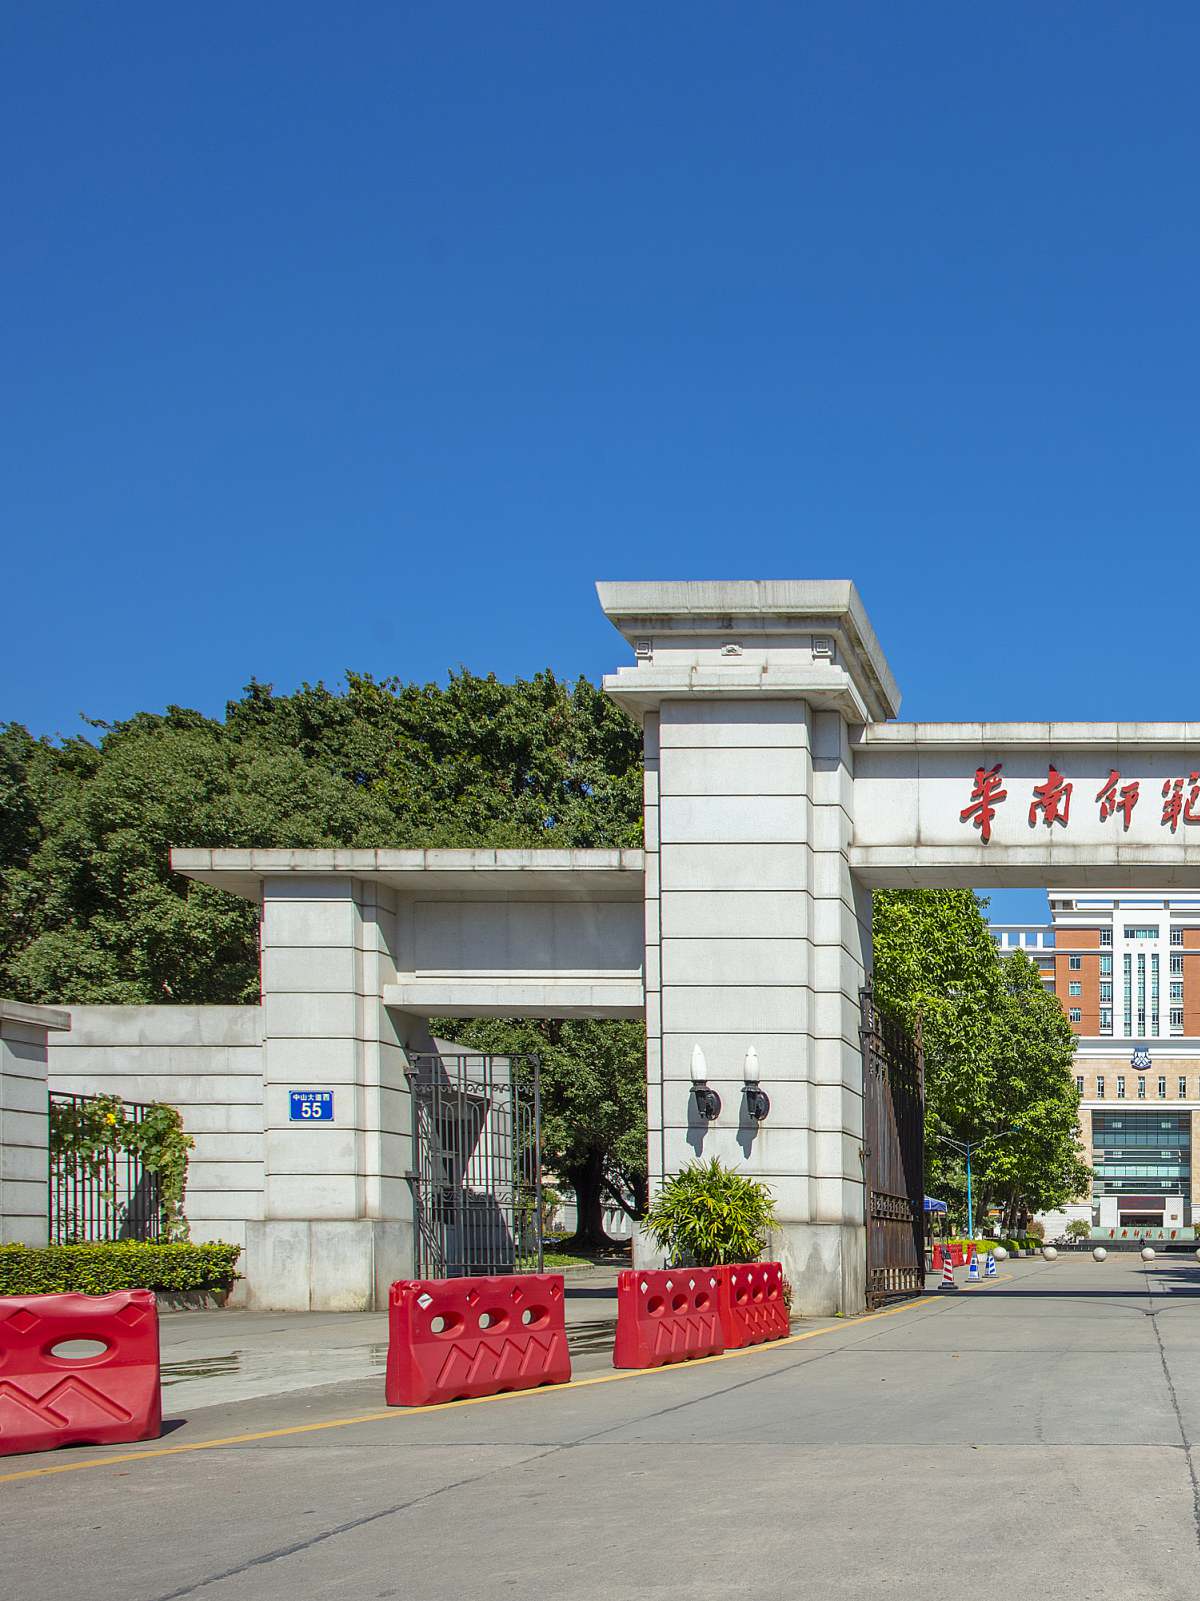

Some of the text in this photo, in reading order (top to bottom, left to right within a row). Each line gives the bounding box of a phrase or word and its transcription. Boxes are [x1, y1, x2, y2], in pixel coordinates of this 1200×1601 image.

[292, 1093, 330, 1101] 中山大道西
[301, 1102, 322, 1118] 55
